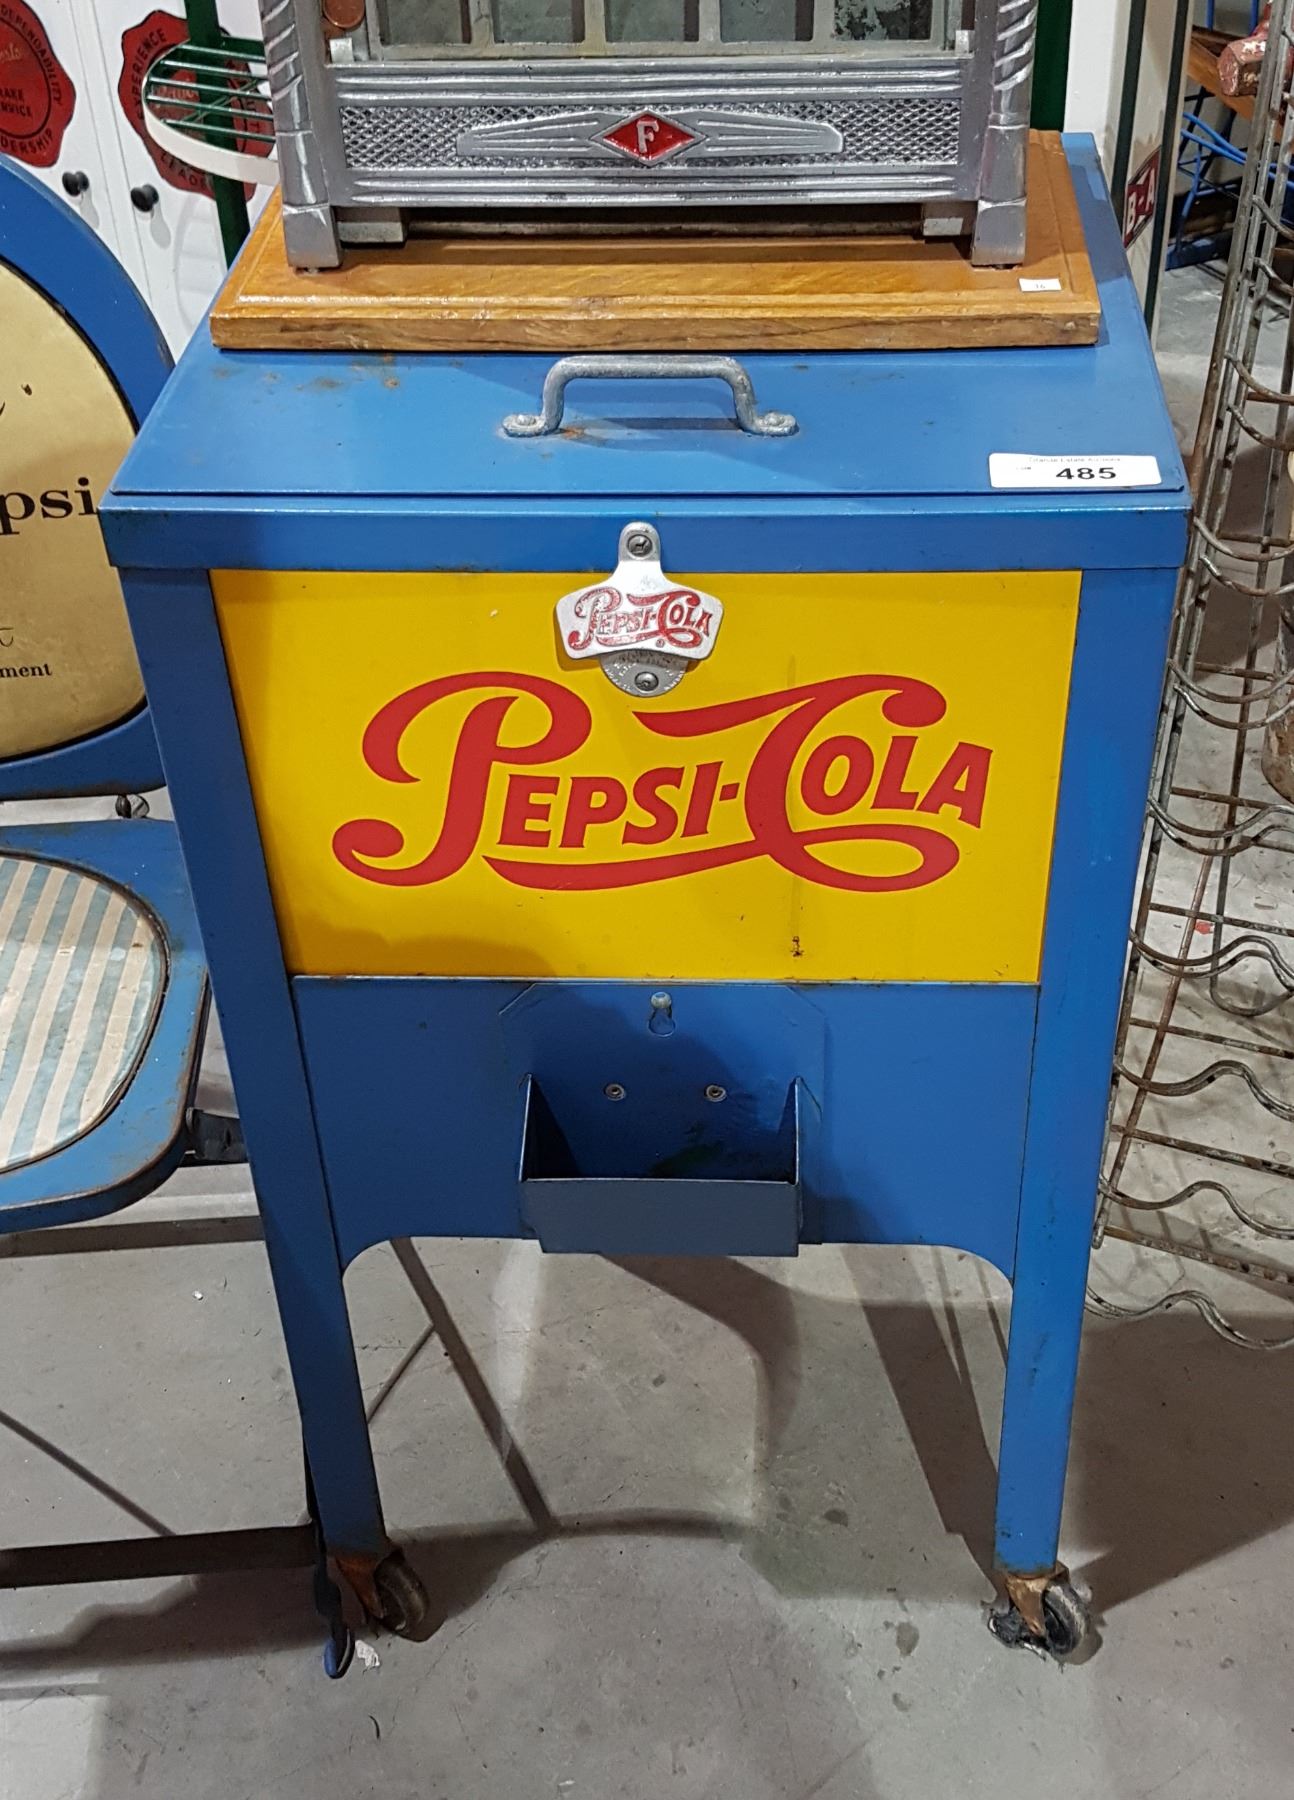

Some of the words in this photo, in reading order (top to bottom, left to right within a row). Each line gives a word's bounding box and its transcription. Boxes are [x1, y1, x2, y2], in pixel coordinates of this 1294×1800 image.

[636, 120, 660, 153] F
[1055, 467, 1117, 480] 485
[567, 586, 713, 650] PEPSI-COLA
[332, 671, 993, 892] PEPSI-COLA
